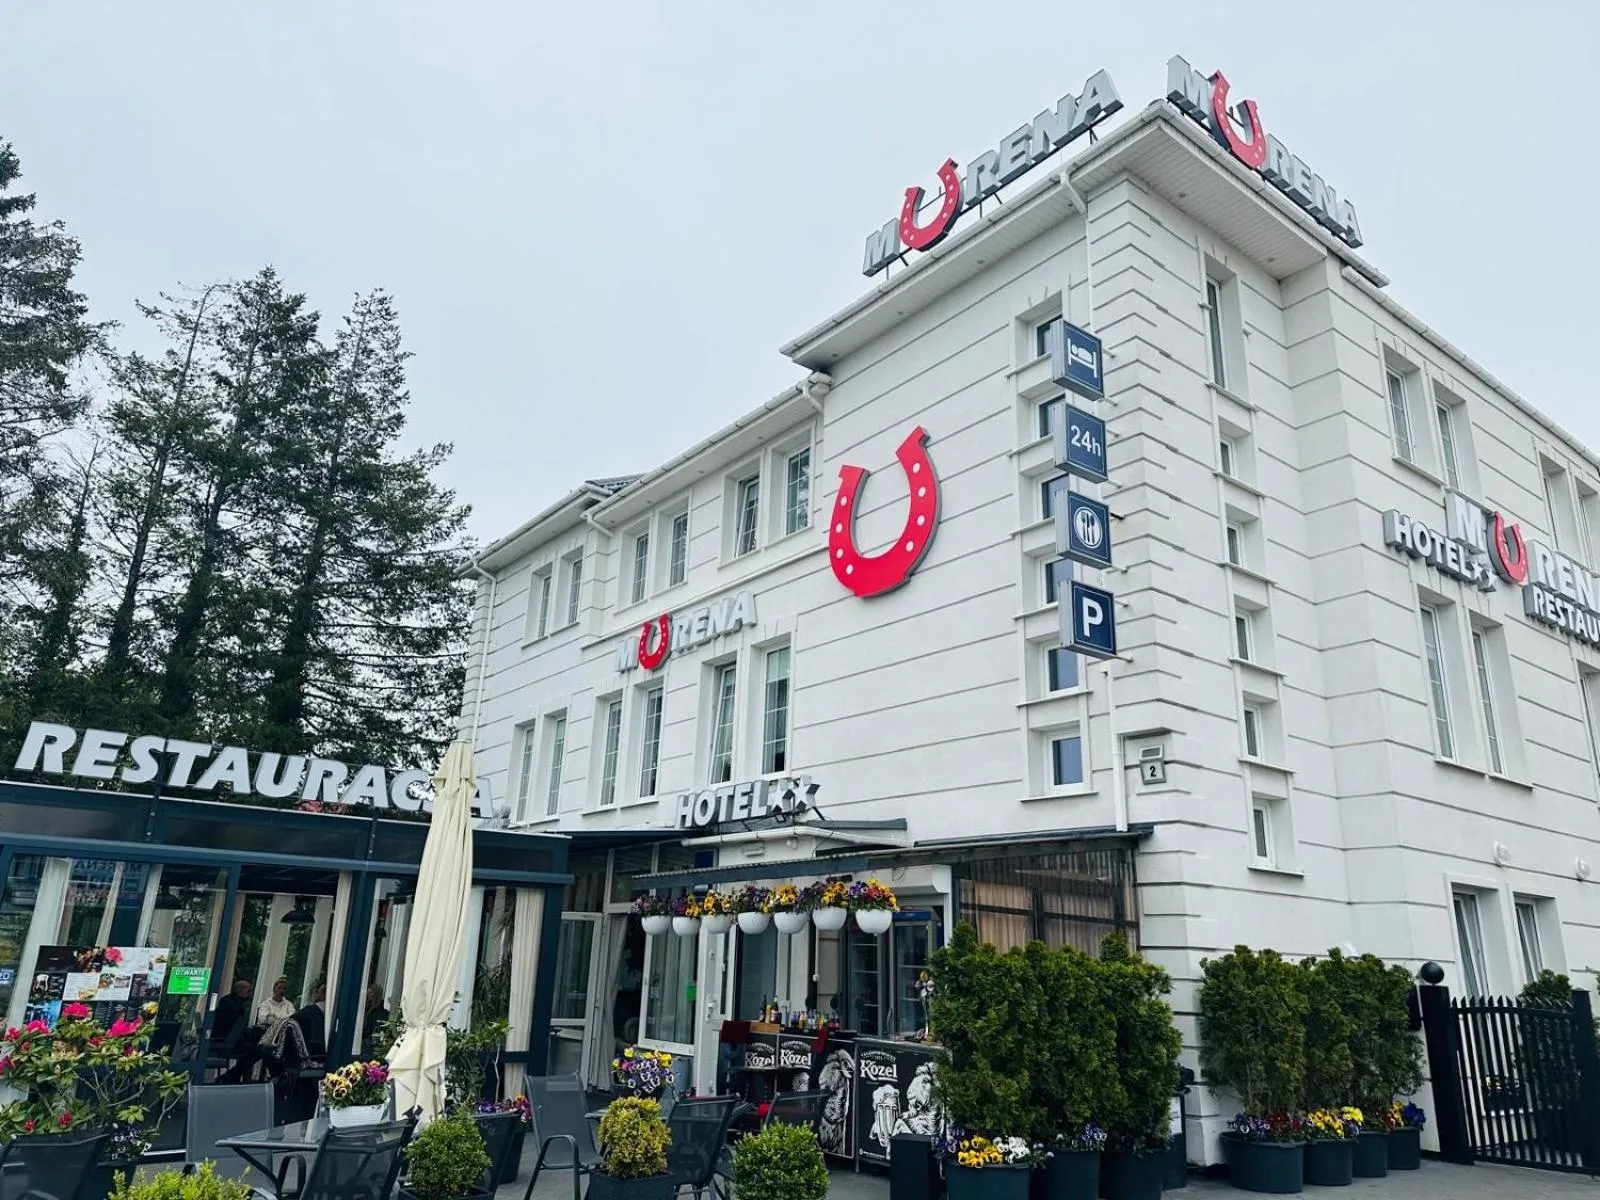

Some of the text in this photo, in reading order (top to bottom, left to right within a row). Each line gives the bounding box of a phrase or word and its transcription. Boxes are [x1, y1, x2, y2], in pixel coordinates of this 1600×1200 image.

[863, 68, 1124, 277] MURENA
[1167, 54, 1363, 248] MURENA
[1070, 424, 1102, 457] 24h
[1384, 508, 1474, 584] HOTEL
[1444, 487, 1600, 616] MUREN
[615, 591, 757, 672] MURENA
[1082, 596, 1103, 637] P
[1523, 583, 1600, 643] RESTAU
[14, 720, 494, 819] RESTAURACA
[1149, 765, 1157, 778] 2
[674, 780, 771, 829] HOTEL
[779, 1049, 812, 1069] Kozel
[860, 1059, 898, 1082] Kozel
